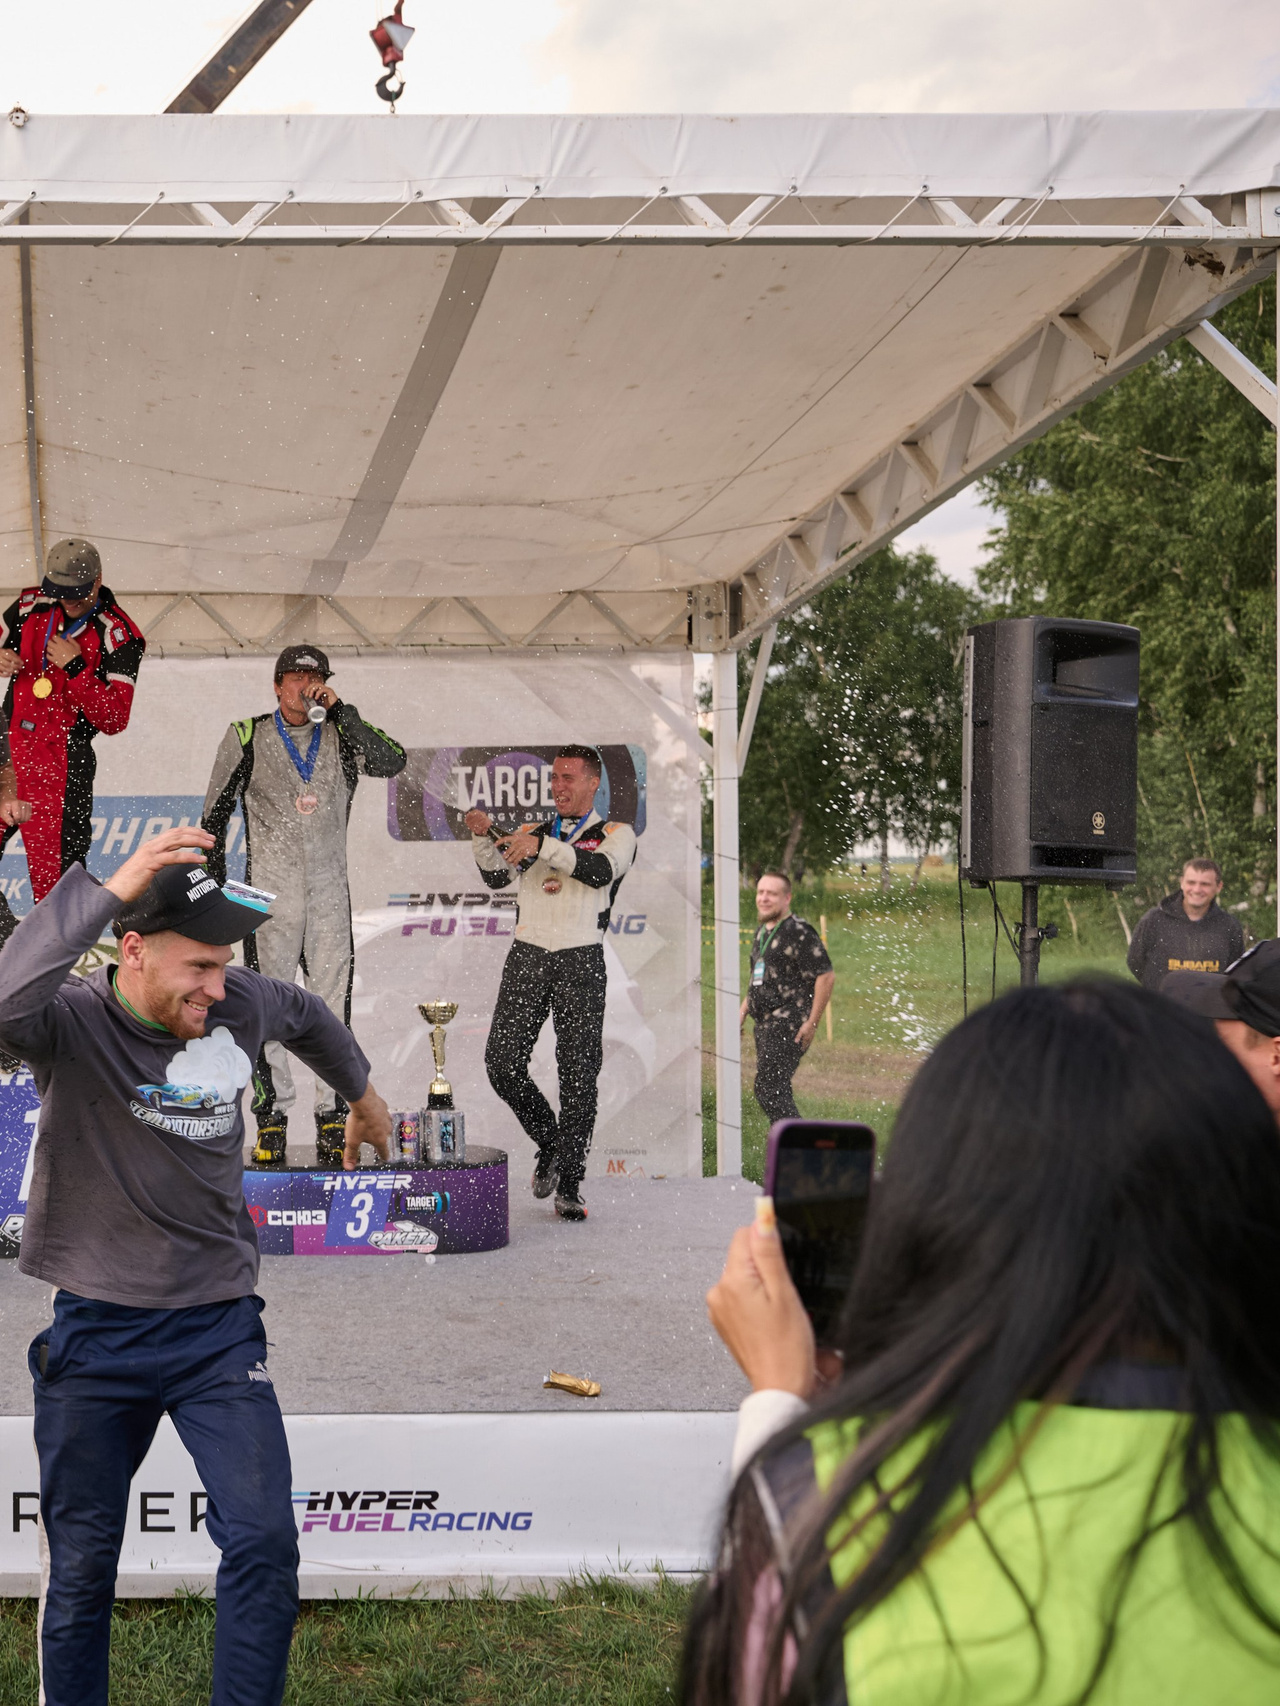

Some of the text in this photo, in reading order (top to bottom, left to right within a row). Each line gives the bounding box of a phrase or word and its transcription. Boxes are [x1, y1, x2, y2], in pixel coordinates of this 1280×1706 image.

[451, 764, 556, 808] TARGE
[406, 892, 518, 914] HYPE
[323, 1174, 413, 1190] HYPER
[406, 1196, 436, 1207] TARGET
[267, 1209, 327, 1226] СОЮЗ
[346, 1192, 373, 1238] 3
[306, 1490, 439, 1510] HYPER
[12, 1492, 209, 1532] RER
